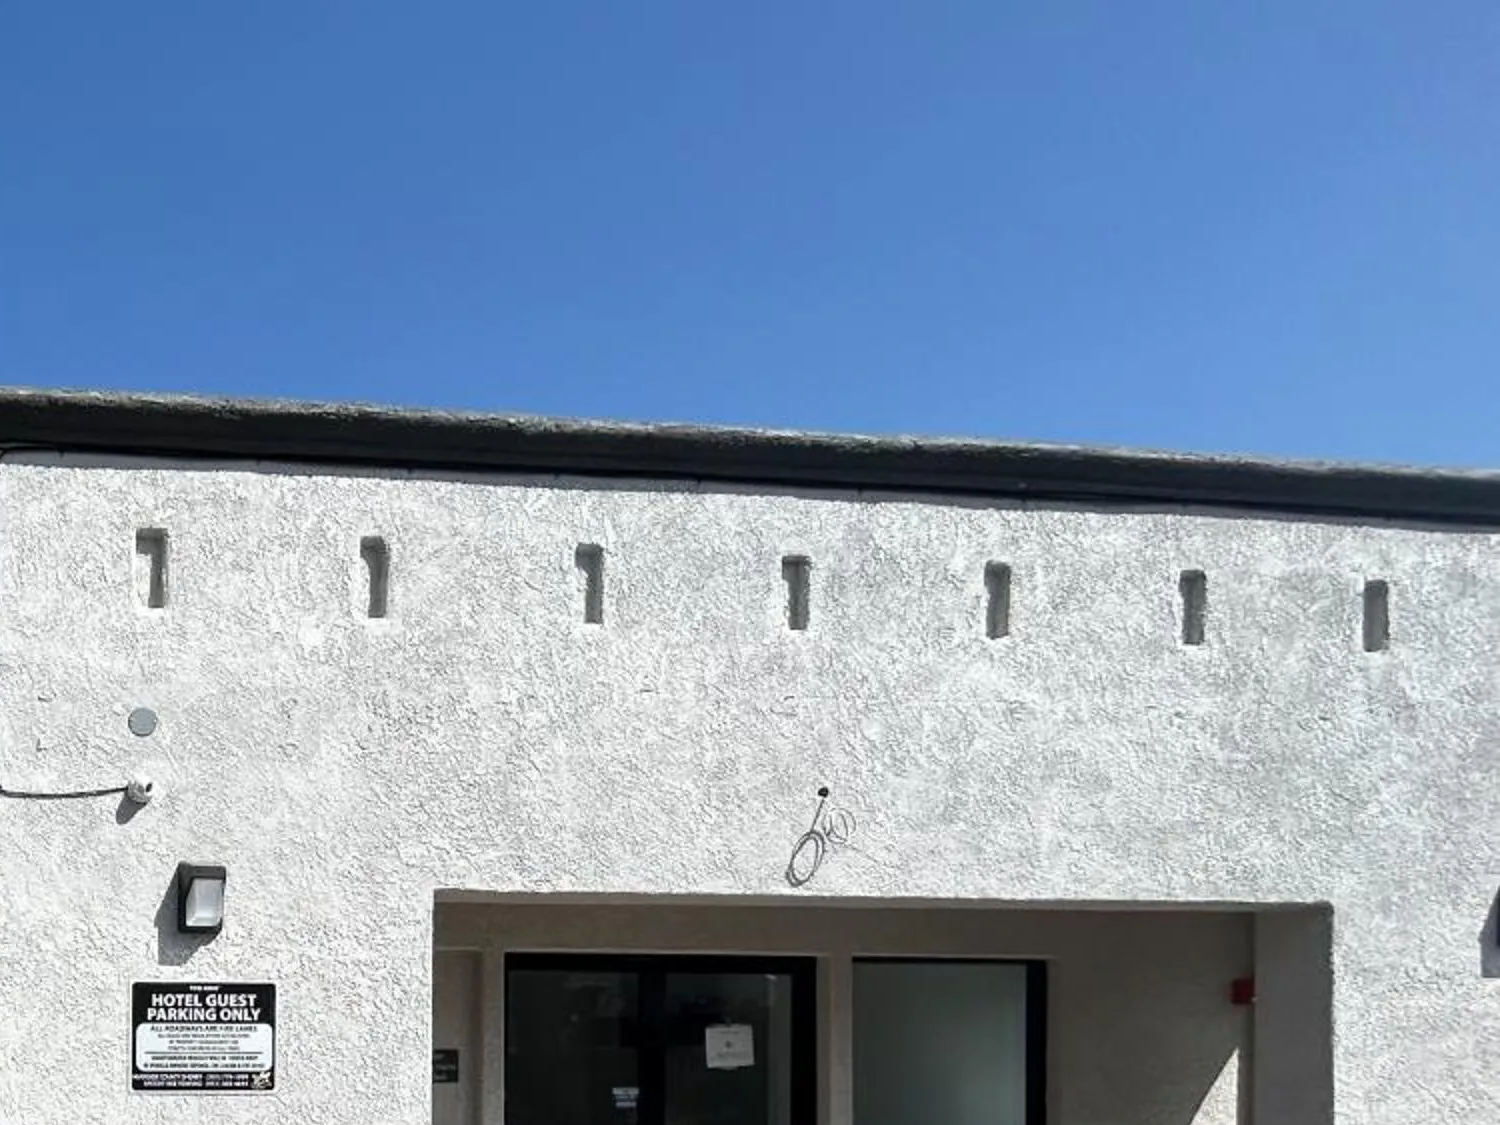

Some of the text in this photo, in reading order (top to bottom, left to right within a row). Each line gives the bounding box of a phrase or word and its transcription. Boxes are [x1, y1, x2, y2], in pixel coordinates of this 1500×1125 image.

[151, 993, 258, 1007] HOTEL GUEST
[147, 1007, 261, 1021] PARKING ONLY
